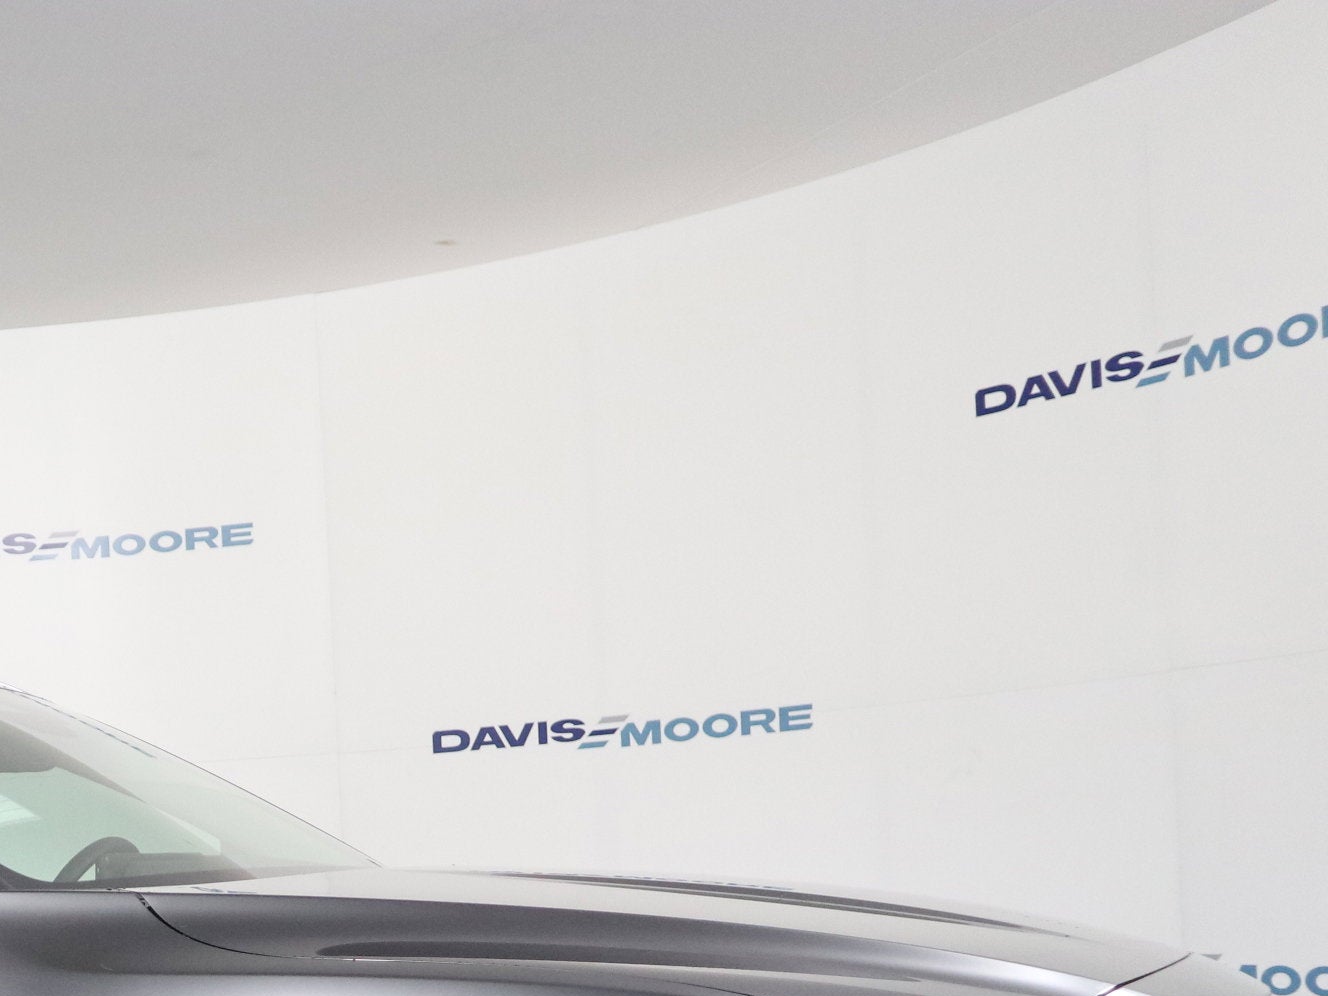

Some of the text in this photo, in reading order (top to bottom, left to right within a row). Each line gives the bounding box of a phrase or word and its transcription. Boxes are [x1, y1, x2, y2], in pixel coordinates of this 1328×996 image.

[974, 304, 1328, 418] DAVIS MOO
[70, 521, 255, 560] MOORE
[431, 703, 814, 755] DAVIS MOORE
